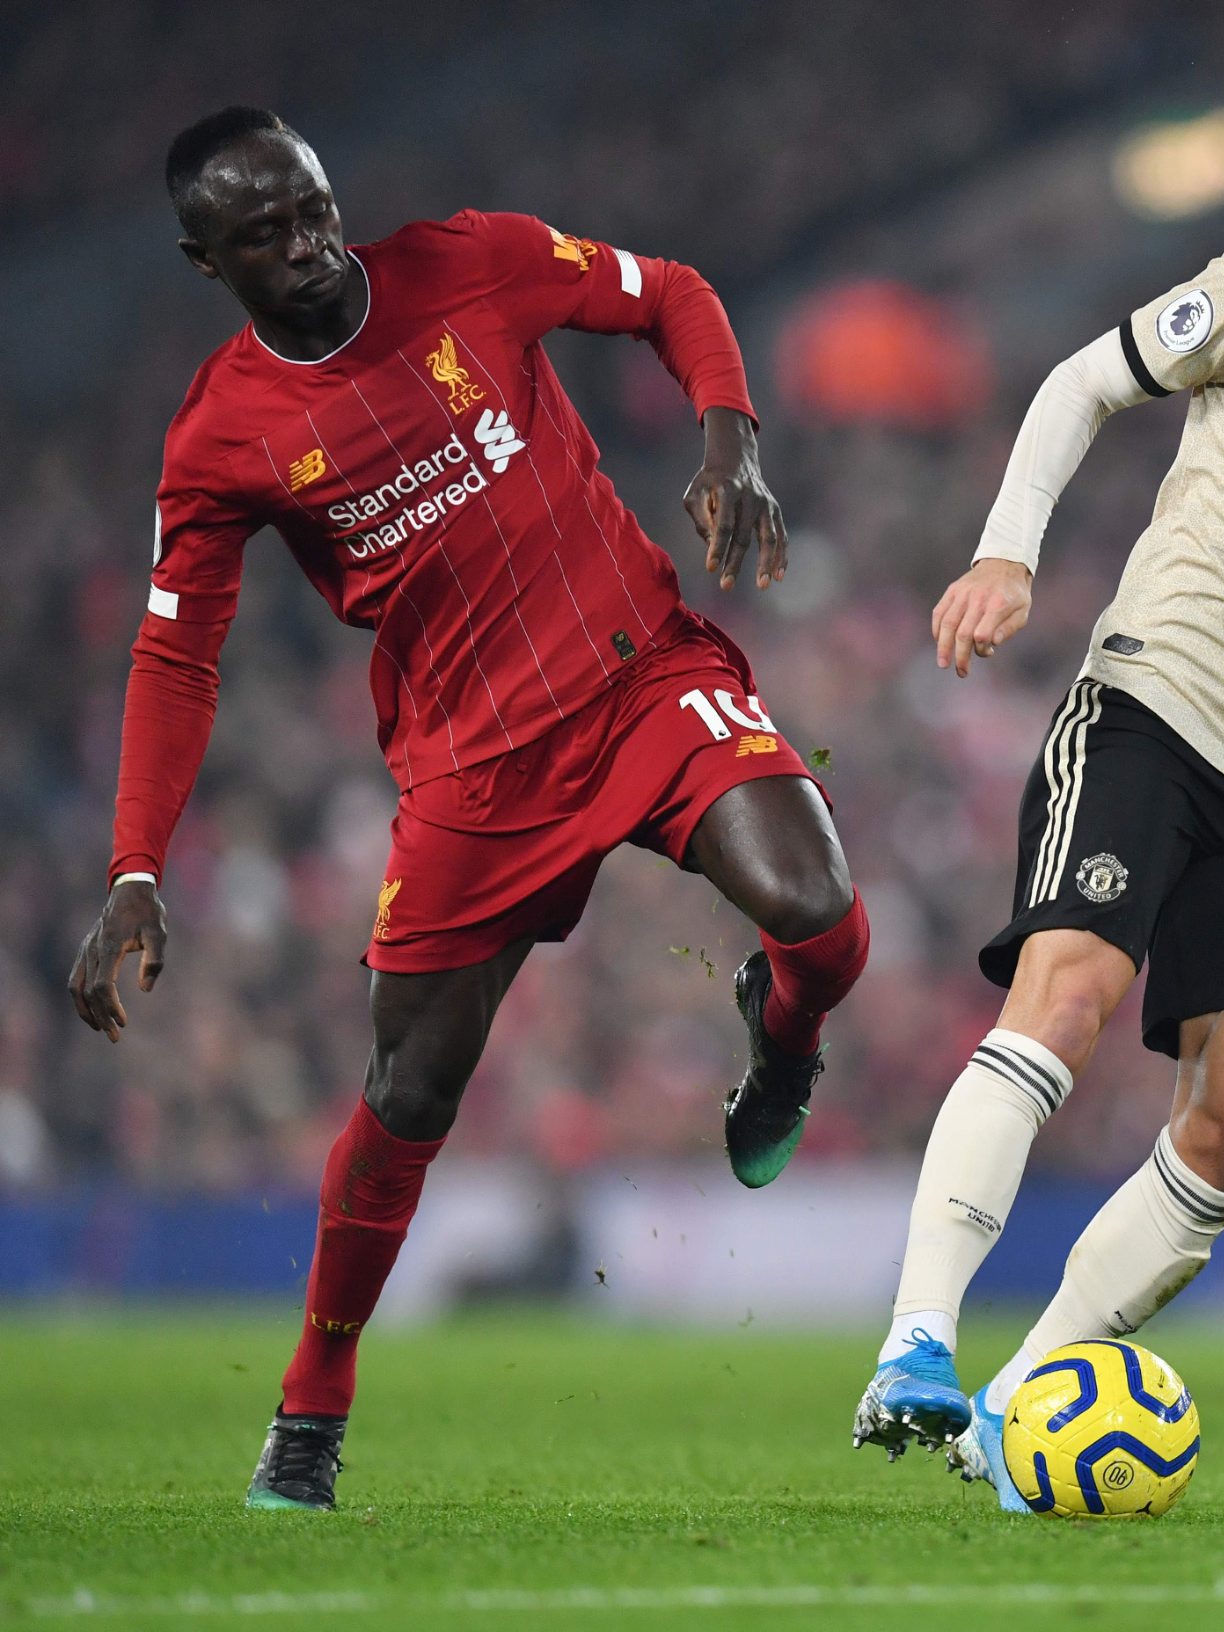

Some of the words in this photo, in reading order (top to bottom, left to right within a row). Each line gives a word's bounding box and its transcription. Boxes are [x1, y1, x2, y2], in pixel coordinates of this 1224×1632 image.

[328, 433, 468, 529] Standard
[344, 462, 488, 559] Chartered
[679, 688, 778, 741] 10
[1084, 857, 1124, 878] MANCHESTER
[1083, 887, 1112, 900] UNITED
[1108, 1466, 1128, 1486] 06
